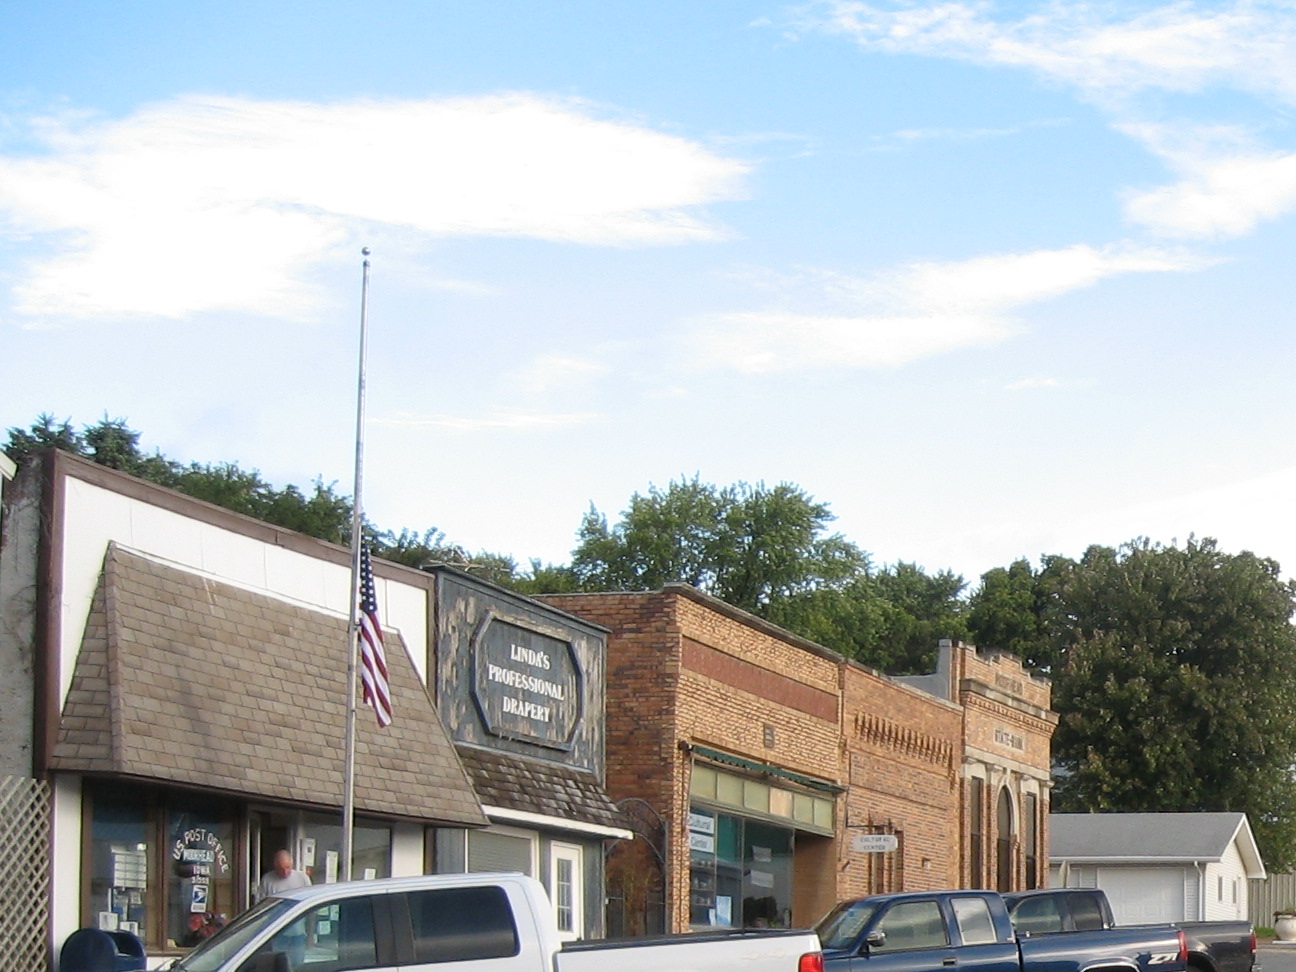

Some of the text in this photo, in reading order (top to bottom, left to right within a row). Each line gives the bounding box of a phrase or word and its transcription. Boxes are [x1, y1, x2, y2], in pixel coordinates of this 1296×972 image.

[510, 644, 551, 670] LINDA'S
[488, 663, 564, 701] PROFESSIONAL
[502, 696, 551, 722] DRAPERY
[184, 828, 206, 844] POST
[207, 832, 230, 874] OFFICE
[1147, 952, 1179, 965] Z71
